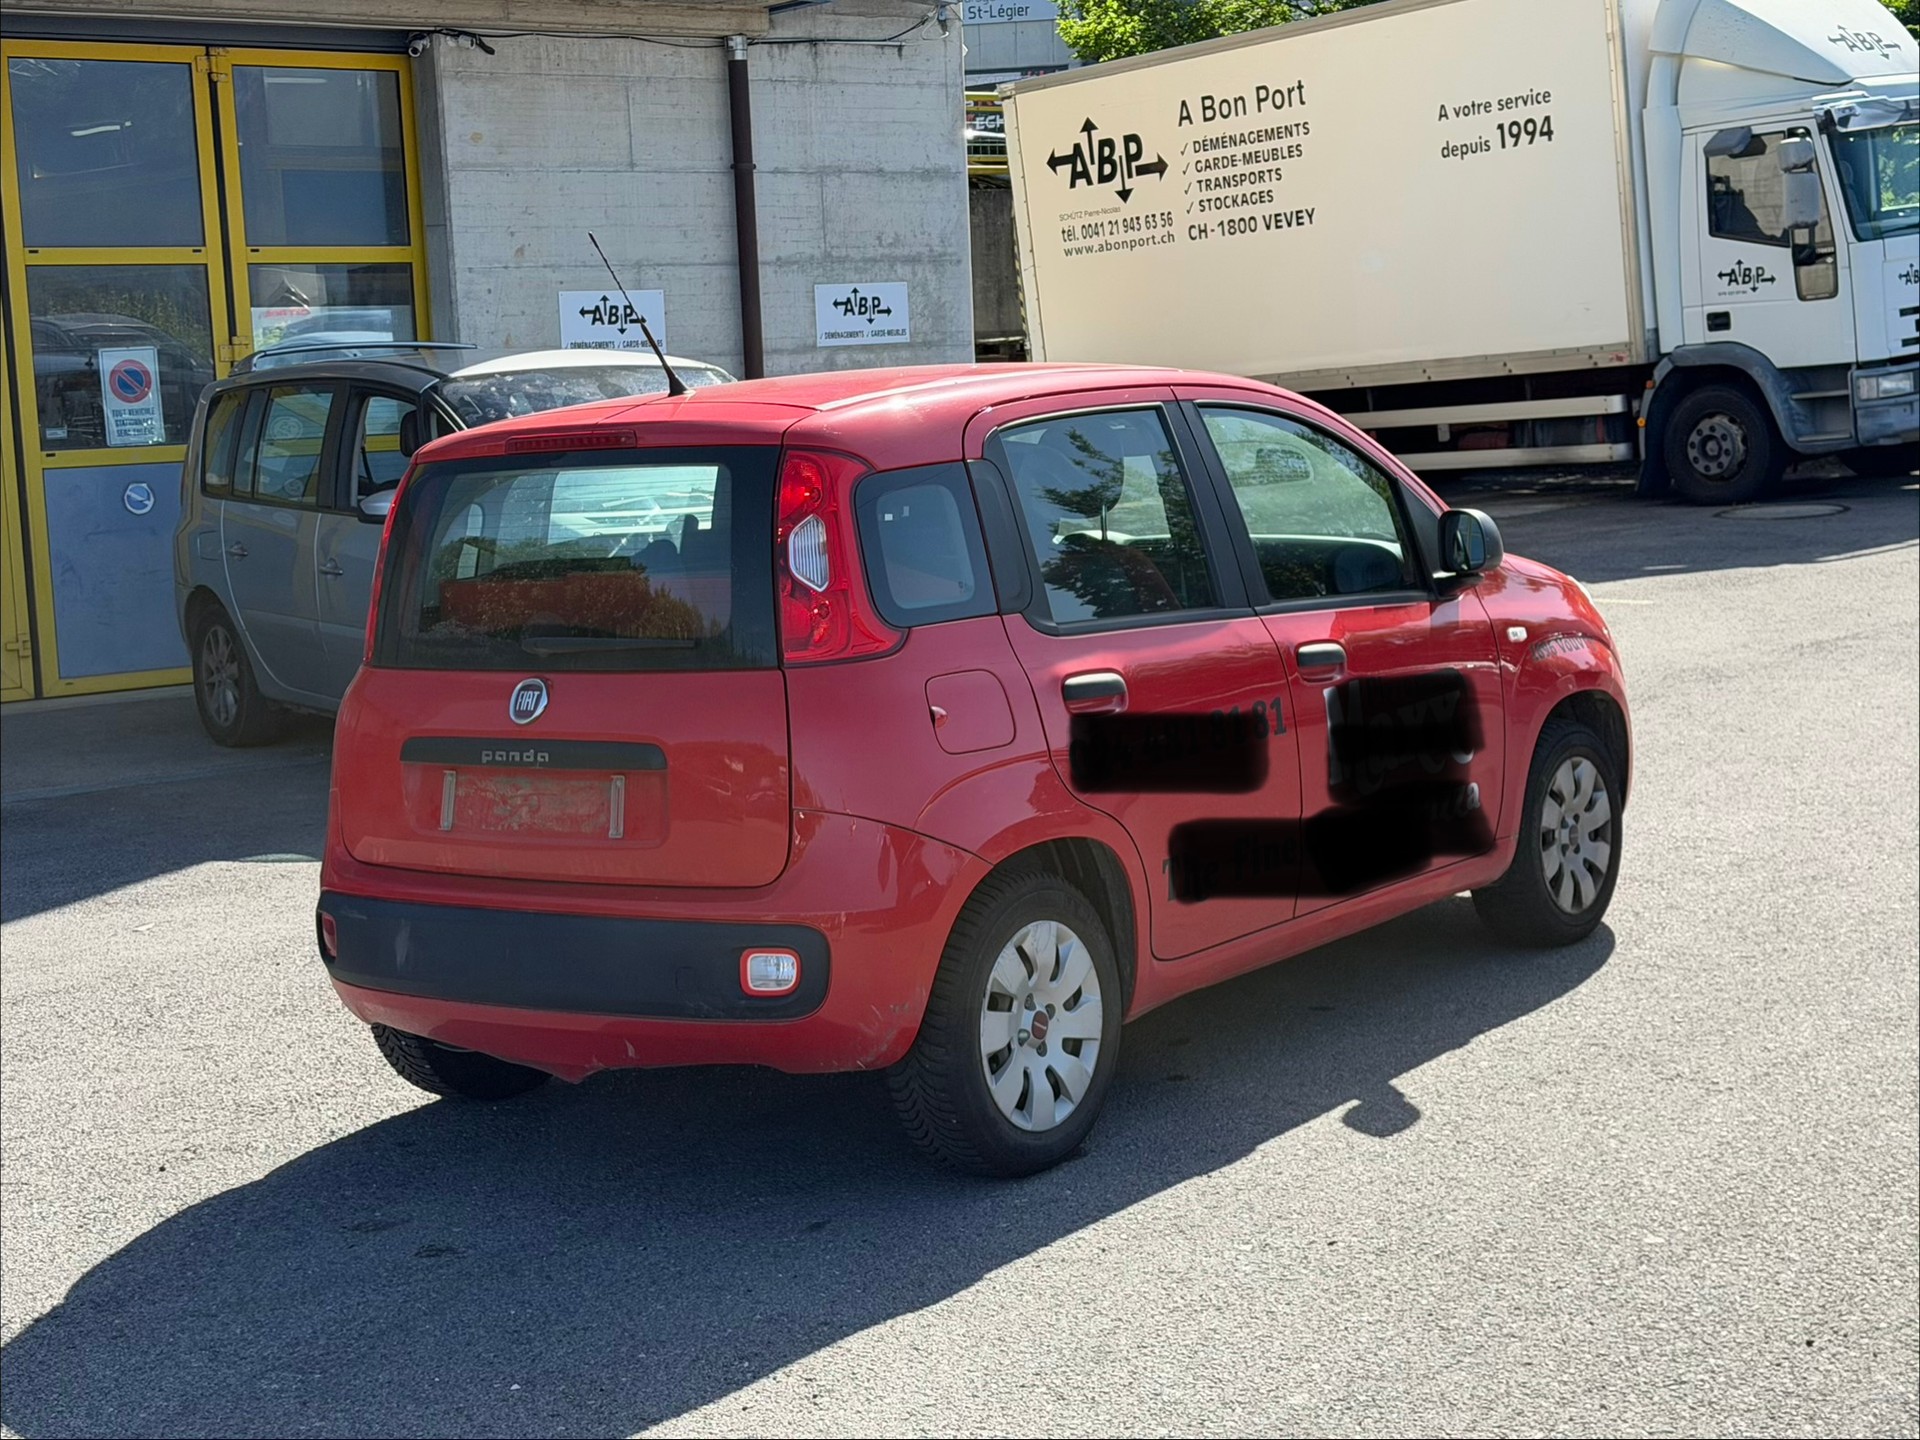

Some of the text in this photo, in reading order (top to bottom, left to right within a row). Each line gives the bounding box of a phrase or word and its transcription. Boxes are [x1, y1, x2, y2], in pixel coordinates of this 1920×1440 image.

[968, 5, 1030, 20] St-Légier
[1178, 79, 1306, 127] A Bon Port
[1438, 88, 1551, 122] A votre service
[1192, 121, 1310, 153] DÉMÉNAGEMENTS
[1441, 115, 1554, 160] depuis 1994
[1195, 144, 1303, 173] GARDE-MEUBLES
[1197, 168, 1282, 193] TRANSPORTS
[1198, 189, 1274, 212] STOCKAGES
[1061, 211, 1173, 242] tél. 0041 21 943 63 56
[1262, 207, 1315, 231] VEVEY
[1063, 230, 1175, 257] www.abonport.ch
[516, 690, 540, 711] FIAT
[481, 749, 549, 763] panda
